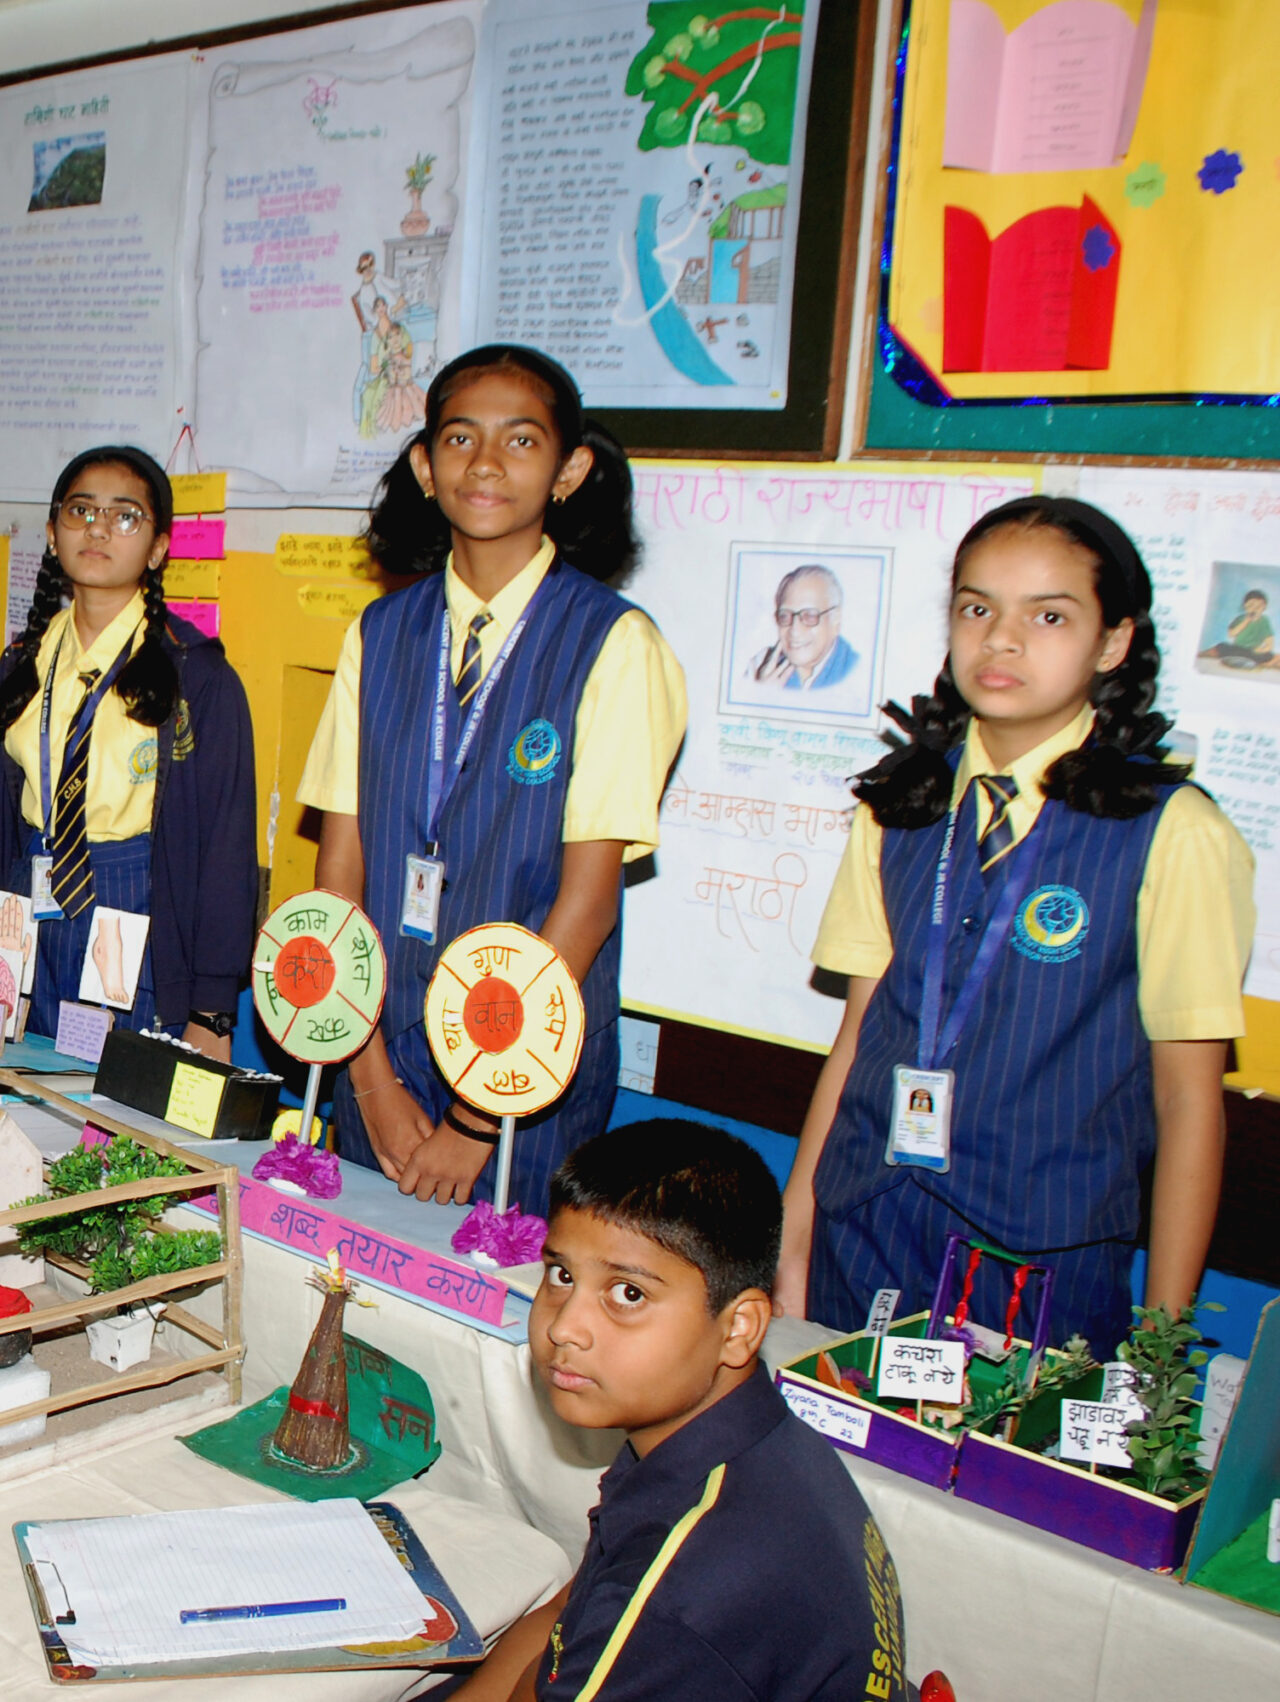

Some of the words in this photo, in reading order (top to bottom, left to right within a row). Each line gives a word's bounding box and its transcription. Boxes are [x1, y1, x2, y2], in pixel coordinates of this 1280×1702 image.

[634, 467, 750, 531] मराठी
[283, 908, 330, 933] काम
[695, 851, 809, 957] मराठी
[931, 884, 946, 926] COLLEGE
[282, 943, 332, 990] करी
[350, 927, 377, 997] शेत
[466, 945, 523, 978] गुण
[471, 1000, 520, 1033] वान
[270, 1203, 327, 1249] शब्द
[336, 1225, 415, 1286] तयार
[426, 1262, 498, 1313] करणे
[893, 1344, 944, 1364] कचरा
[1068, 1402, 1129, 1427] झाडावर
